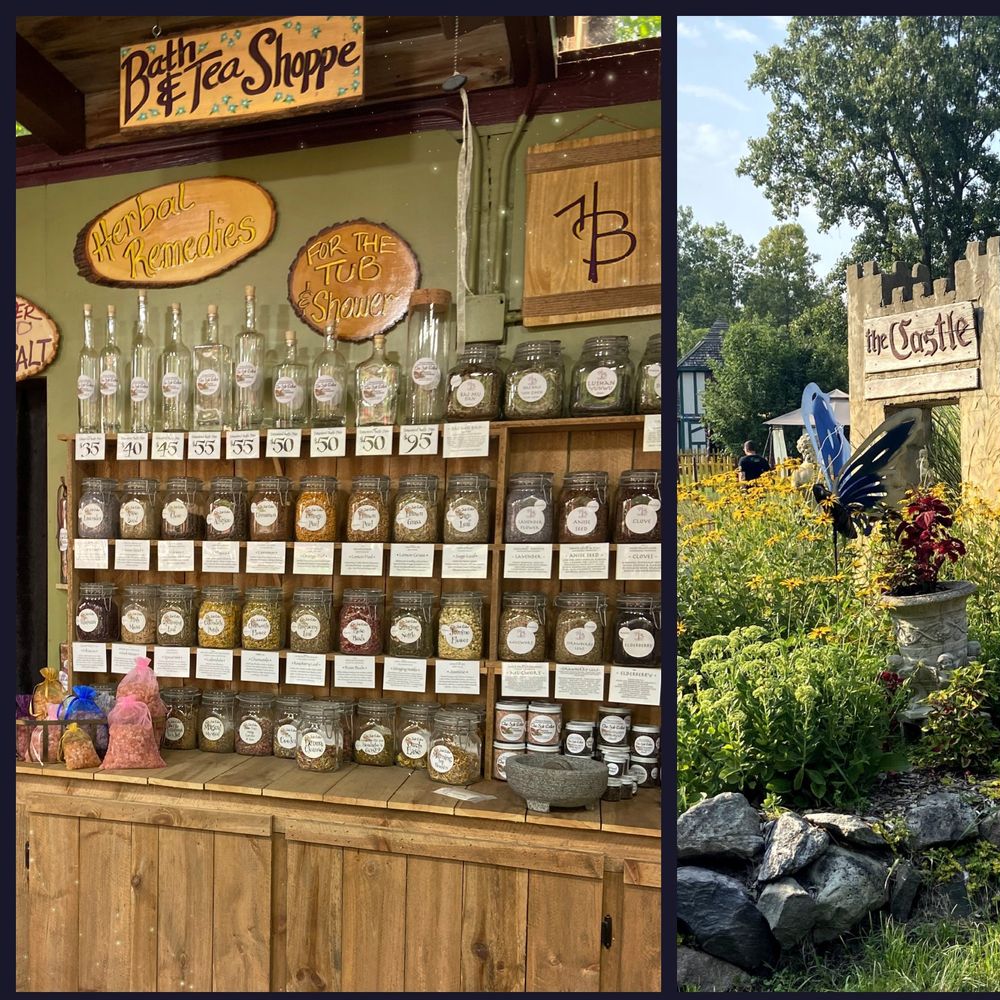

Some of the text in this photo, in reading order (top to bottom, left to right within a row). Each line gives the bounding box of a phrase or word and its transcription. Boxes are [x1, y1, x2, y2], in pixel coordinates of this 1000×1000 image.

[121, 37, 197, 125] Bath
[157, 27, 361, 117] & Tea Shoppe
[92, 181, 195, 263] Herbal
[123, 210, 257, 279] Remedies
[306, 231, 397, 265] FOR THE
[314, 255, 382, 285] TUB
[311, 289, 400, 324] Shower
[16, 338, 52, 371] ALT
[865, 310, 973, 361] the Castle
